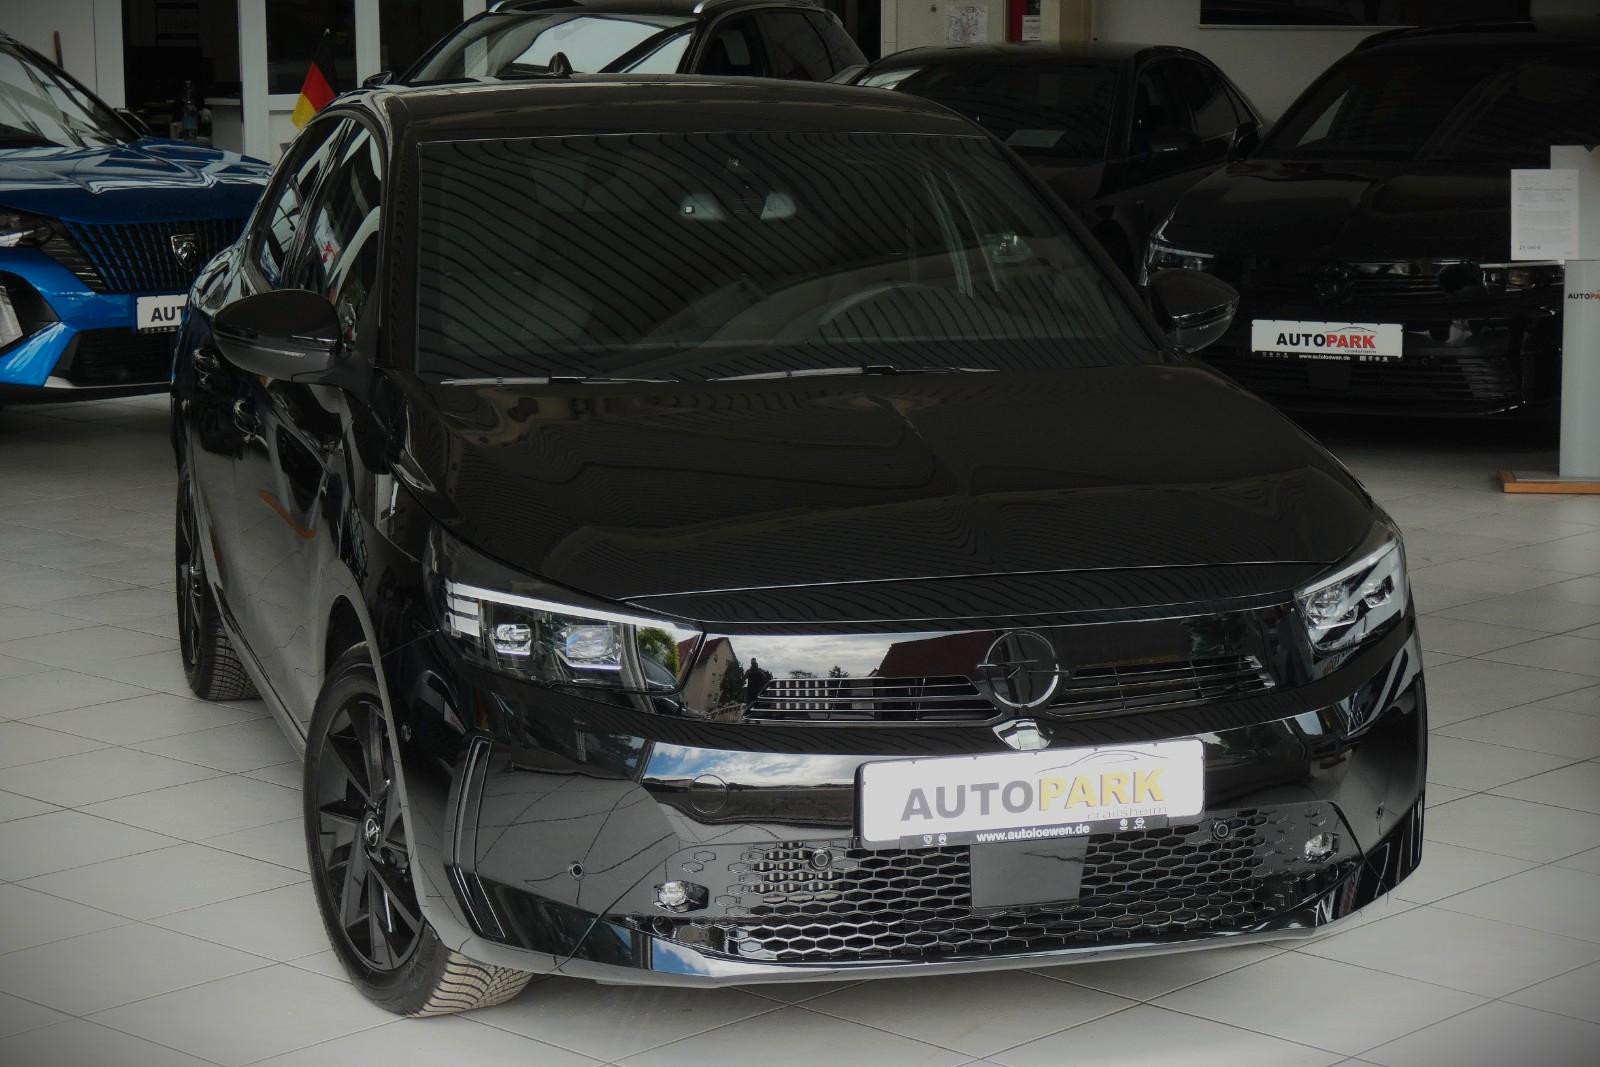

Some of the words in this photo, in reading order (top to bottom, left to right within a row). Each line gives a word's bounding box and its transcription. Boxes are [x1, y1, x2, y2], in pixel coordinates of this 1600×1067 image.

[1276, 332, 1376, 349] AUTOPARK
[901, 768, 1168, 821] AUTOPARK
[976, 824, 1090, 842] www.autoloewen.de
